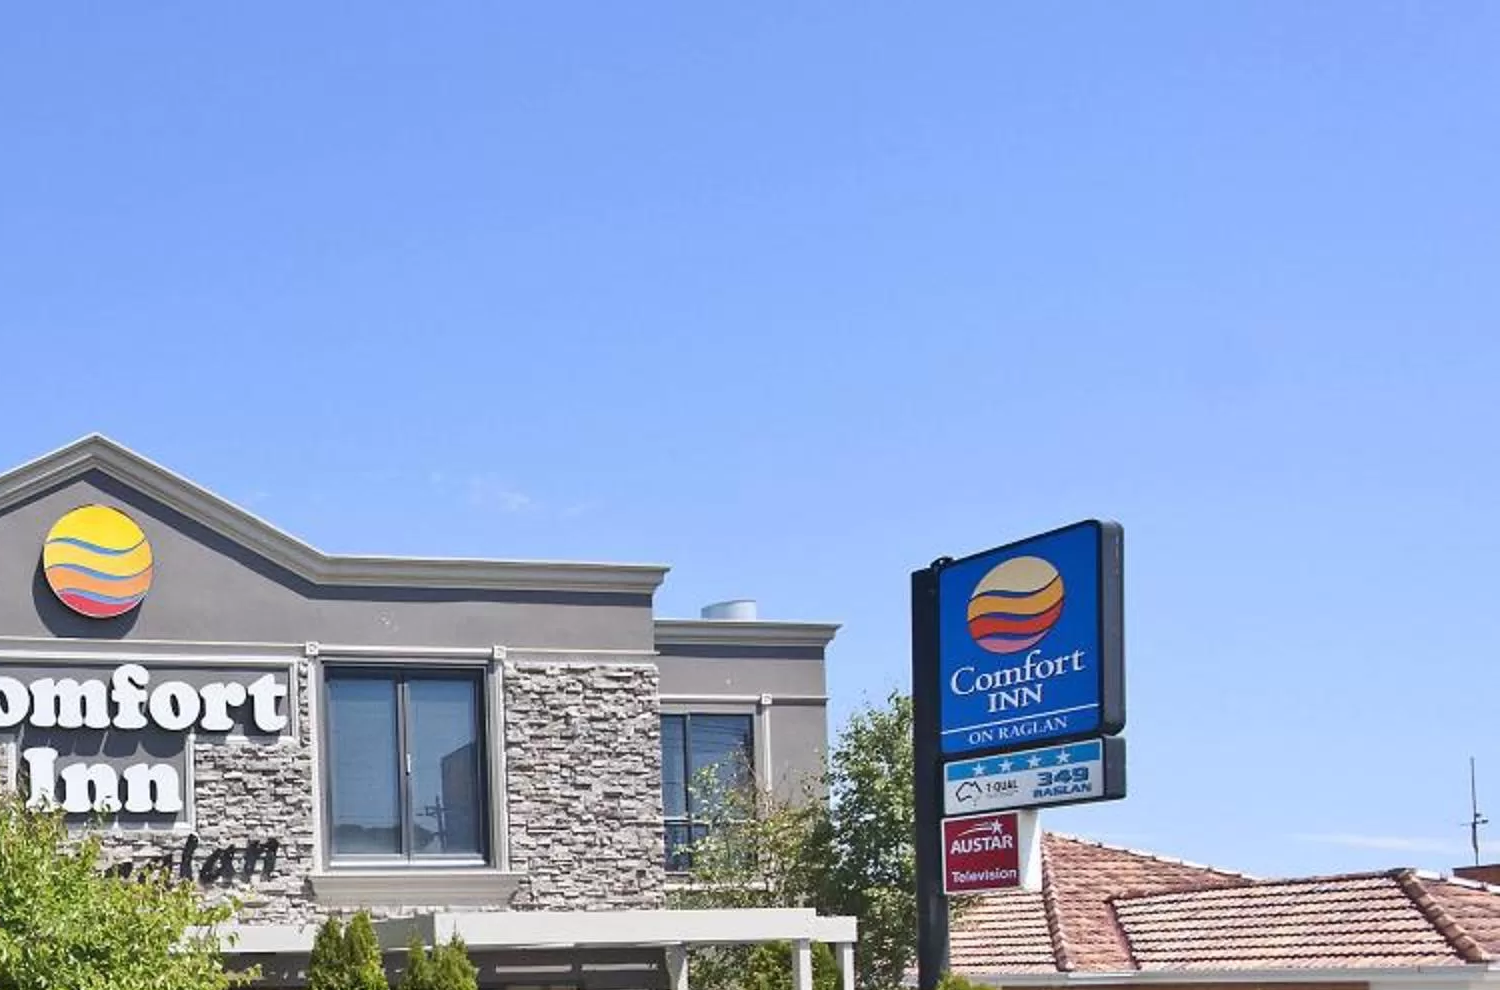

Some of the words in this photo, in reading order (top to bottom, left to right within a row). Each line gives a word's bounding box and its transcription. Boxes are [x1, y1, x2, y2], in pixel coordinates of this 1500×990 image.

[951, 649, 1086, 695] Comfort
[987, 684, 1043, 712] INN
[969, 730, 994, 745] ON
[999, 716, 1069, 740] RAGLAN
[23, 747, 183, 813] Inn
[1036, 767, 1090, 787] 349
[950, 834, 1014, 856] AUSTAR
[952, 867, 1018, 883] Television
